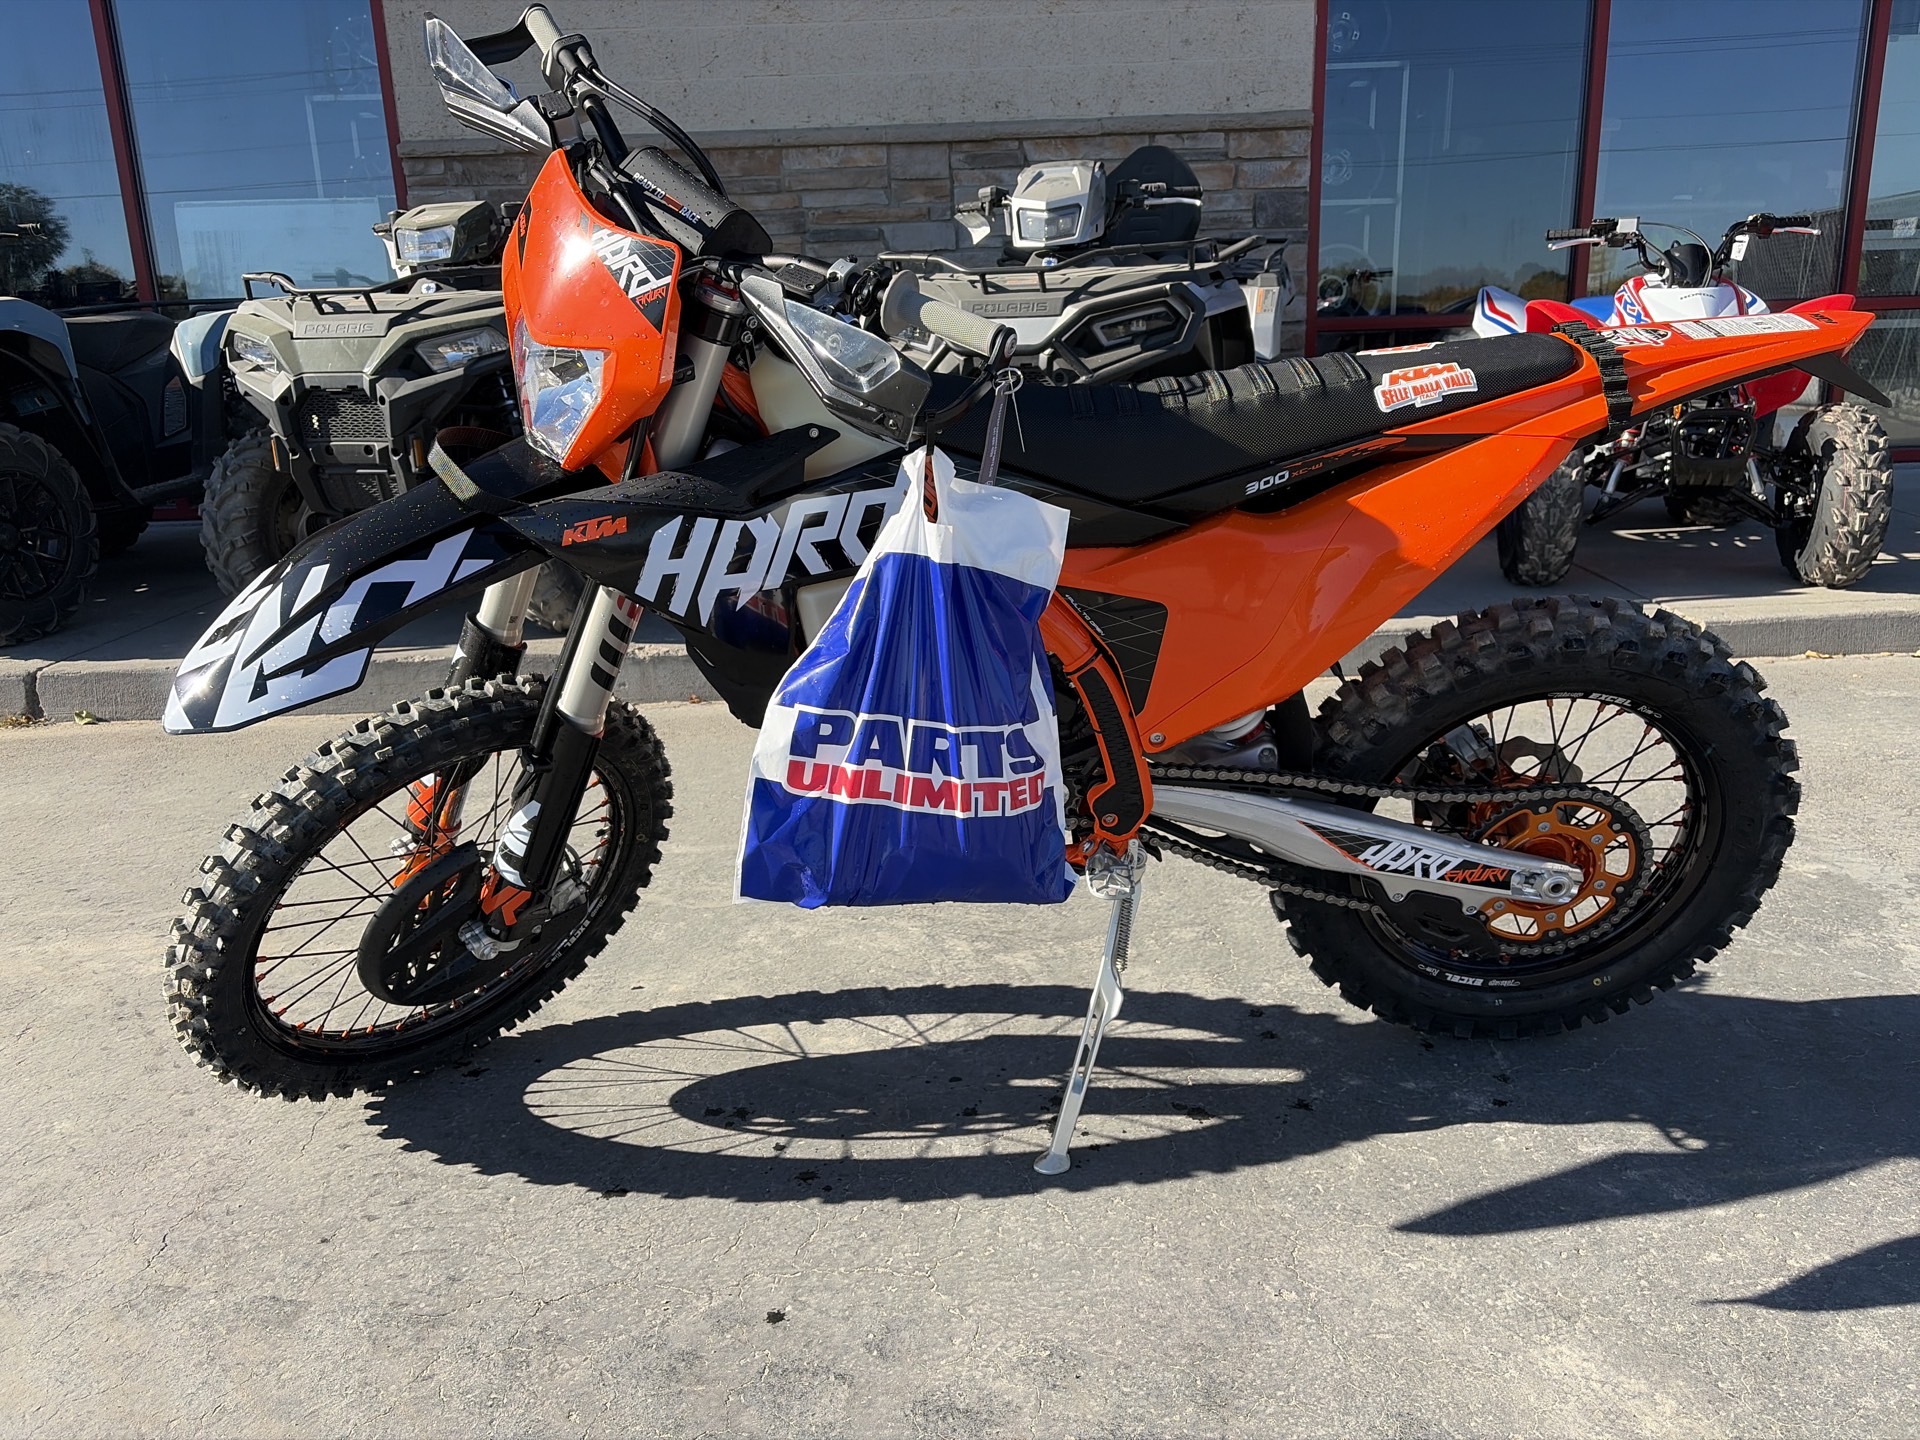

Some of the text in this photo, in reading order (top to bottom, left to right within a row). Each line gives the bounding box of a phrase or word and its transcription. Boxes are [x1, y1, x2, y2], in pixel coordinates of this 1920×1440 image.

[632, 172, 701, 224] READY TO RACE
[972, 301, 1048, 313] POLARIS
[1616, 285, 1650, 324] TRX
[1679, 292, 1716, 300] HONDA
[304, 322, 374, 334] POLARIS
[1381, 370, 1473, 407] SELLE DALLA VALLE
[1388, 363, 1457, 386] KTM
[1420, 391, 1438, 400] ITALY
[1245, 469, 1290, 496] 300
[561, 515, 628, 547] KTM
[1067, 595, 1105, 636] PULL TO OPEN
[1588, 692, 1632, 707] EXCEL
[789, 709, 1045, 780] PARTS
[786, 759, 1046, 814] UNLIMITED
[563, 919, 592, 948] EXCEL
[1445, 972, 1485, 987] EXCEL
